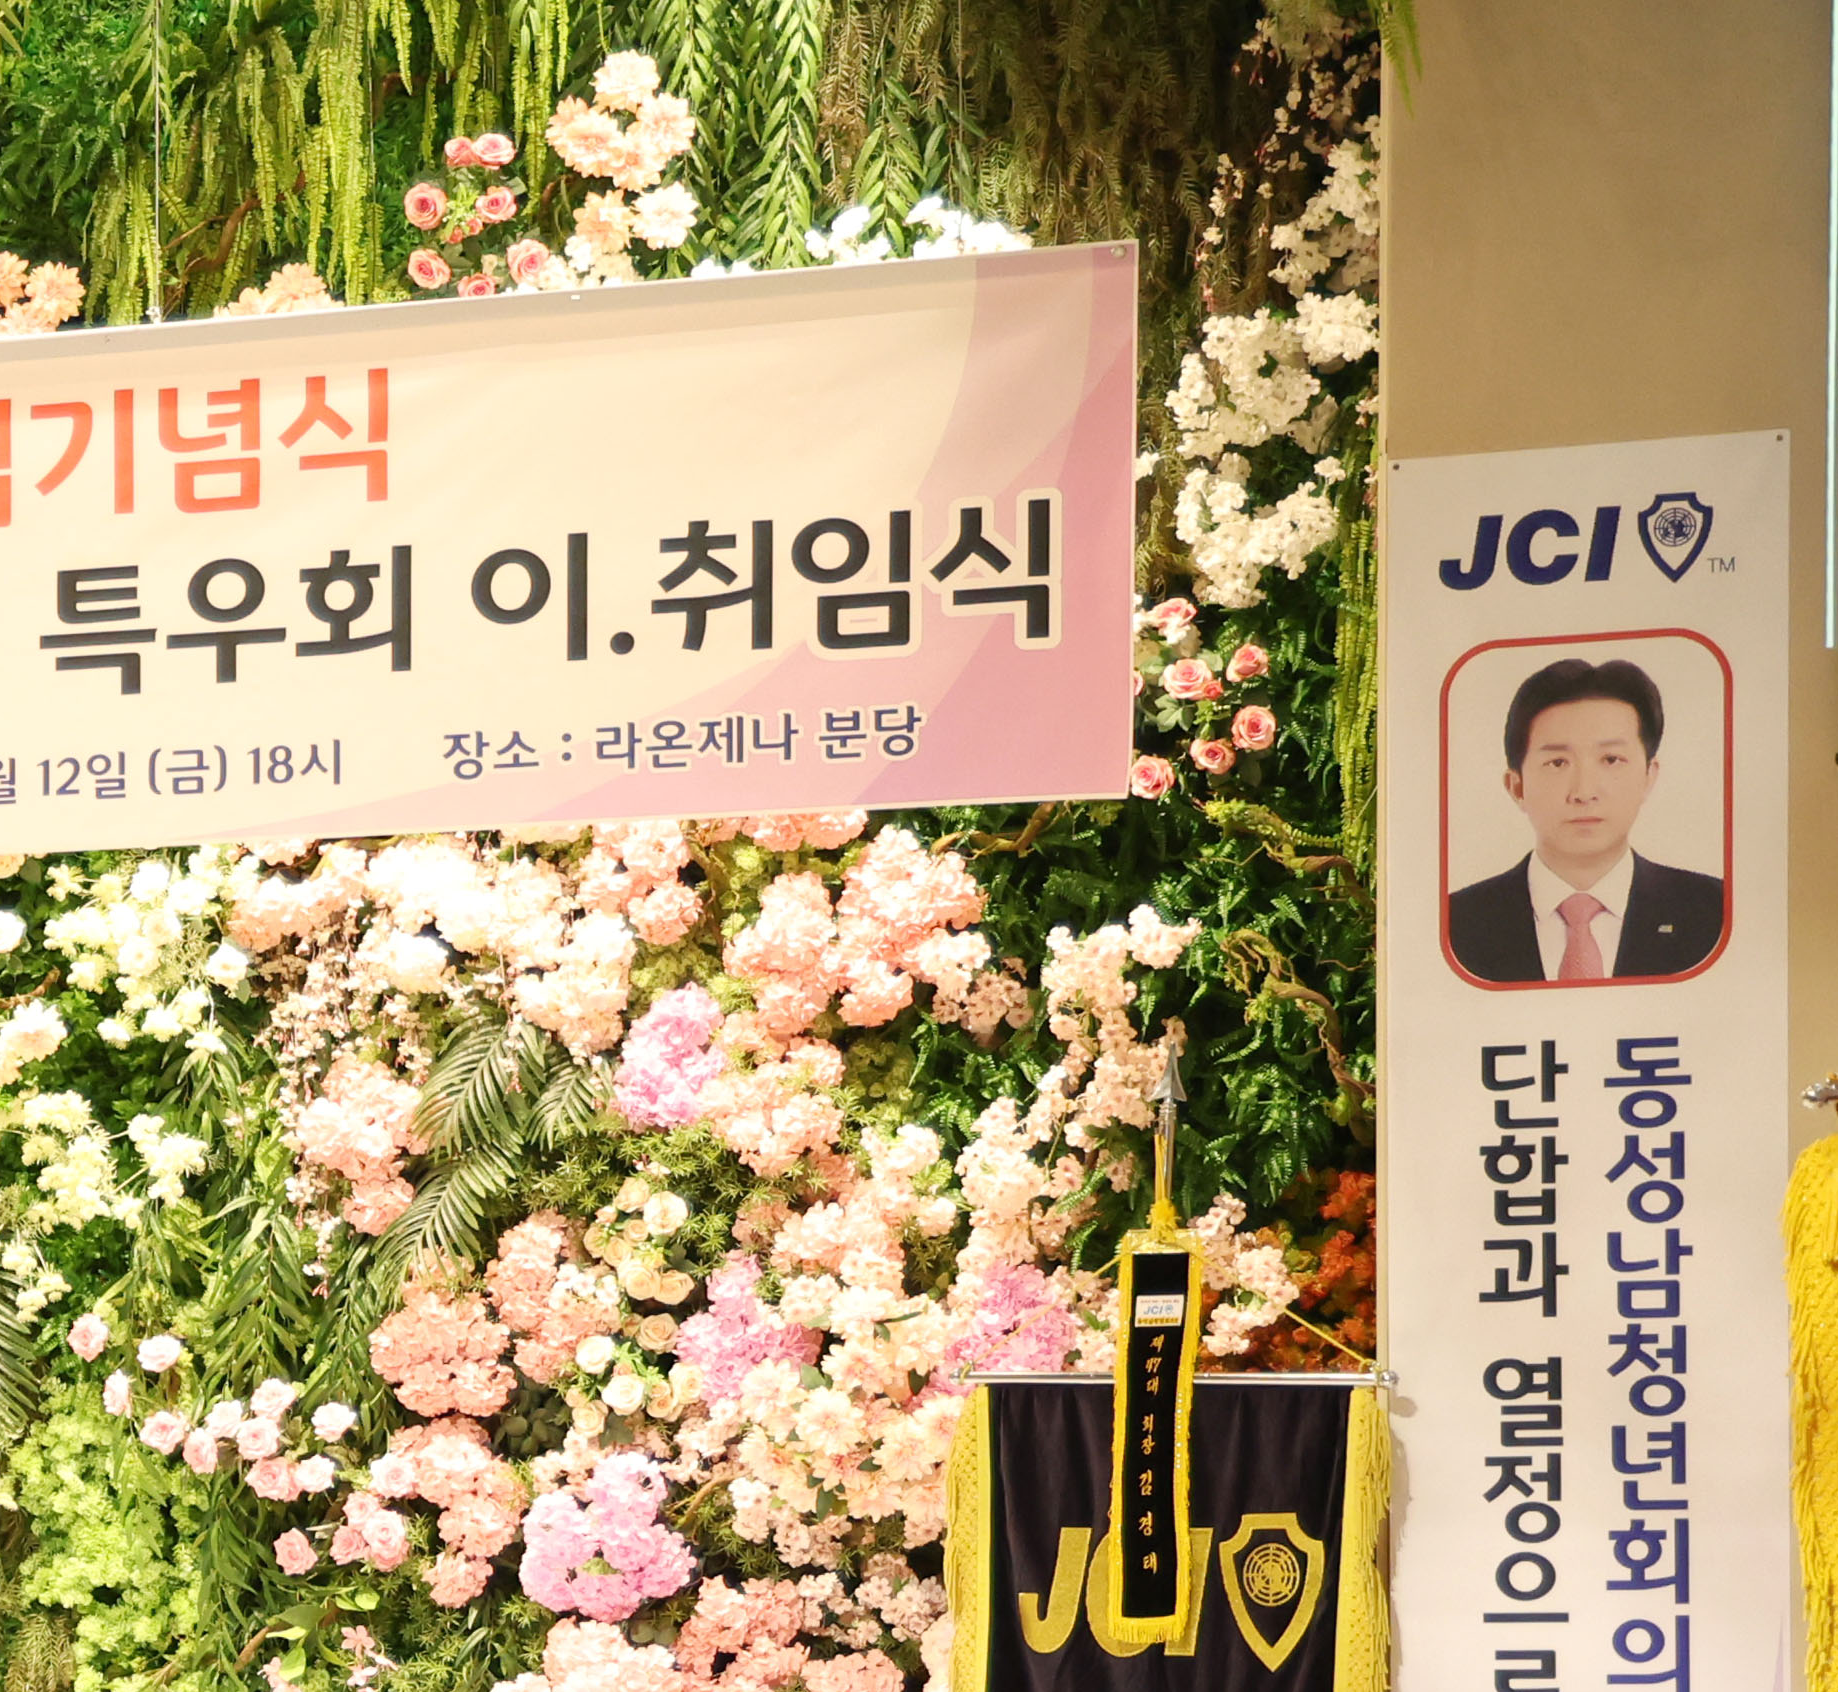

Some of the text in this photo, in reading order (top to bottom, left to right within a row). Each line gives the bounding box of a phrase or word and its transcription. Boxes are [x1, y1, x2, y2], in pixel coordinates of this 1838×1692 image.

[1439, 506, 1621, 591] JCI
[41, 545, 412, 694] 특우회
[472, 498, 1051, 661] 이.취임식
[38, 751, 126, 800] 12일
[148, 744, 227, 795] (금)
[248, 739, 342, 785] 18시
[444, 730, 540, 780] 장소
[596, 713, 799, 769] 라온제나
[819, 705, 922, 759] 분당
[1479, 1040, 1570, 1318] 단합과
